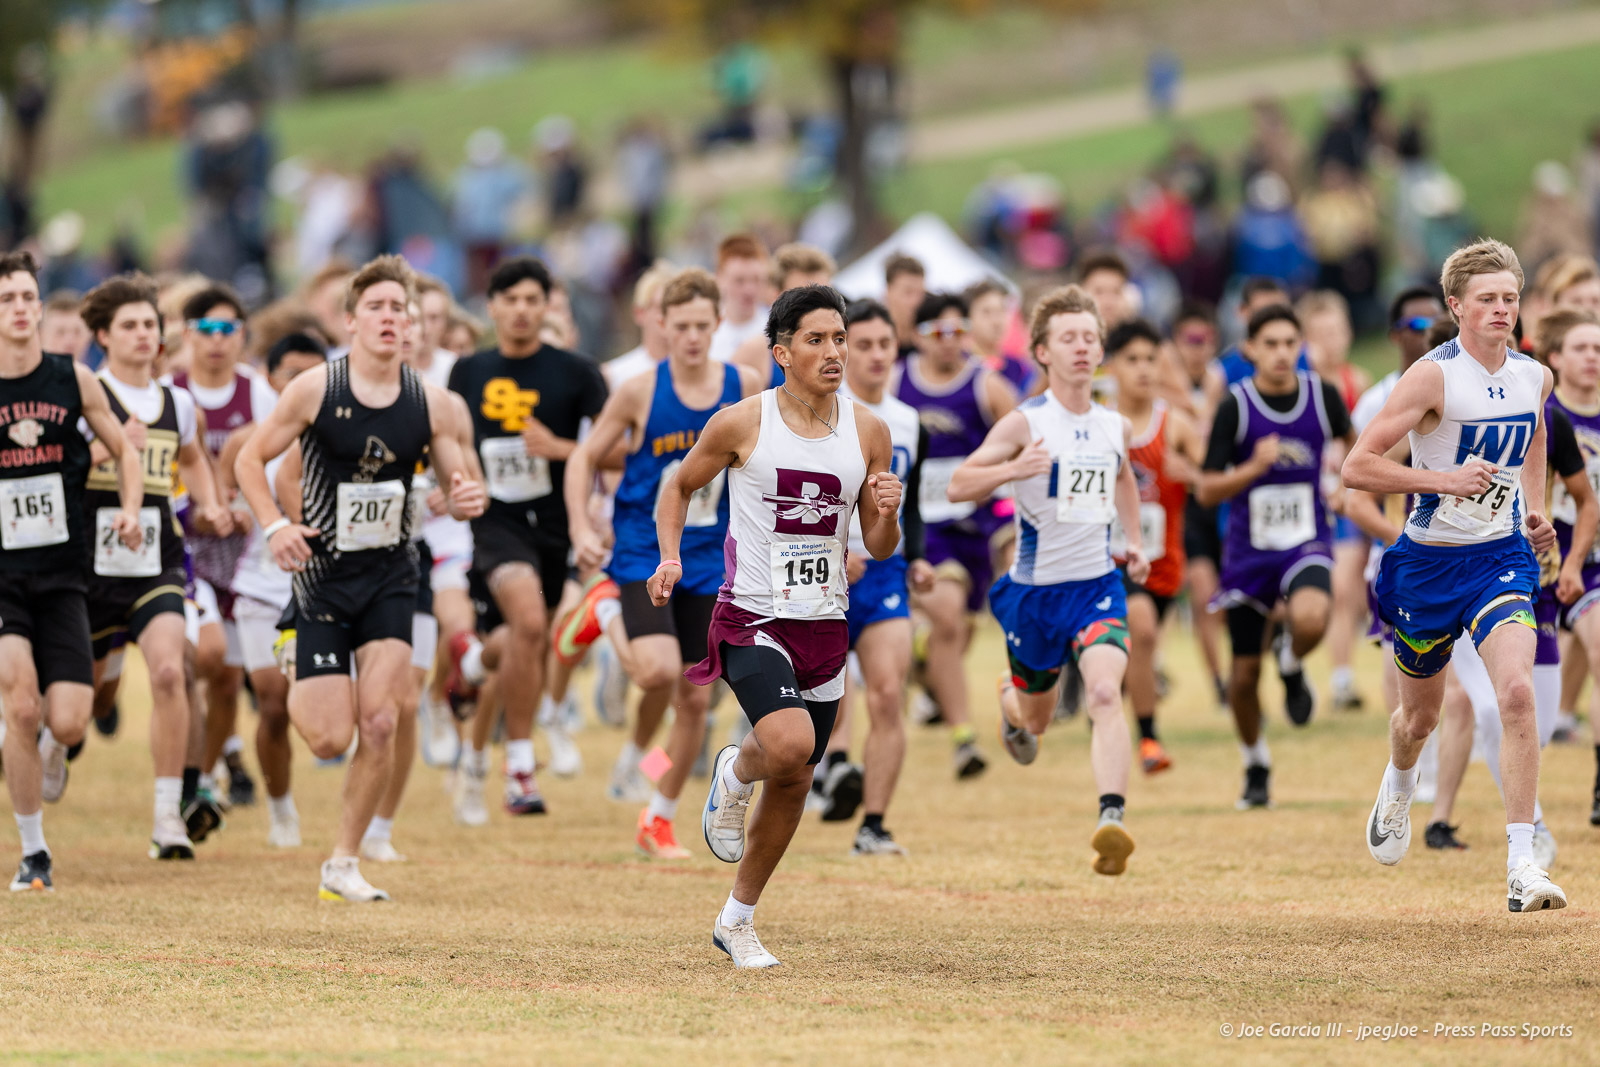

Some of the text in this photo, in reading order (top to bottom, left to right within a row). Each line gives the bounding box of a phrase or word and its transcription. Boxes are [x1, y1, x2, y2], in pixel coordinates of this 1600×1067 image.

[652, 430, 703, 457] BULL
[0, 445, 63, 468] OUGARS
[1071, 470, 1106, 493] 271
[13, 493, 52, 518] 165
[1465, 481, 1511, 510] 75
[351, 499, 392, 523] 207
[103, 526, 155, 548] 28
[801, 541, 822, 550] Region
[791, 548, 832, 557] Championship
[785, 557, 829, 587] 159
